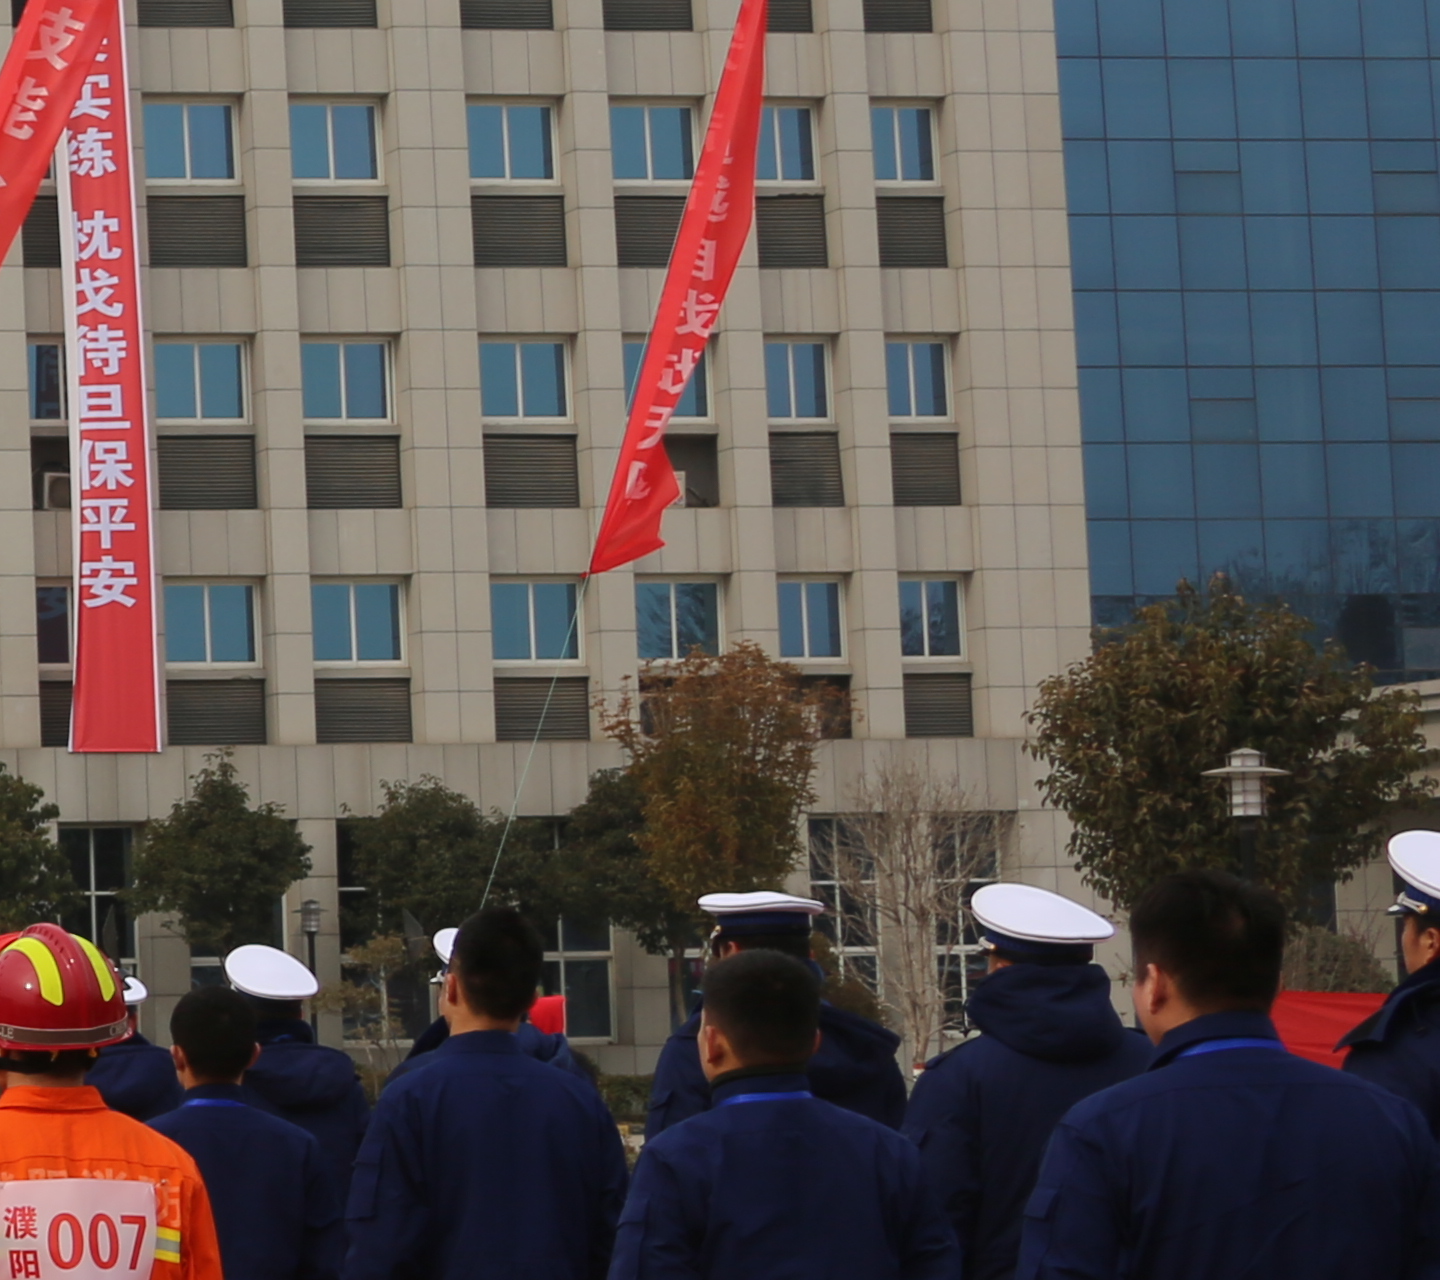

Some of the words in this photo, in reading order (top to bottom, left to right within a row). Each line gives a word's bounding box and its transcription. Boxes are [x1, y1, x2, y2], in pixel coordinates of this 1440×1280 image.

[71, 210, 138, 608] 枕戈待旦保平安
[3, 1205, 41, 1280] 濮阳
[47, 1212, 149, 1272] 007
